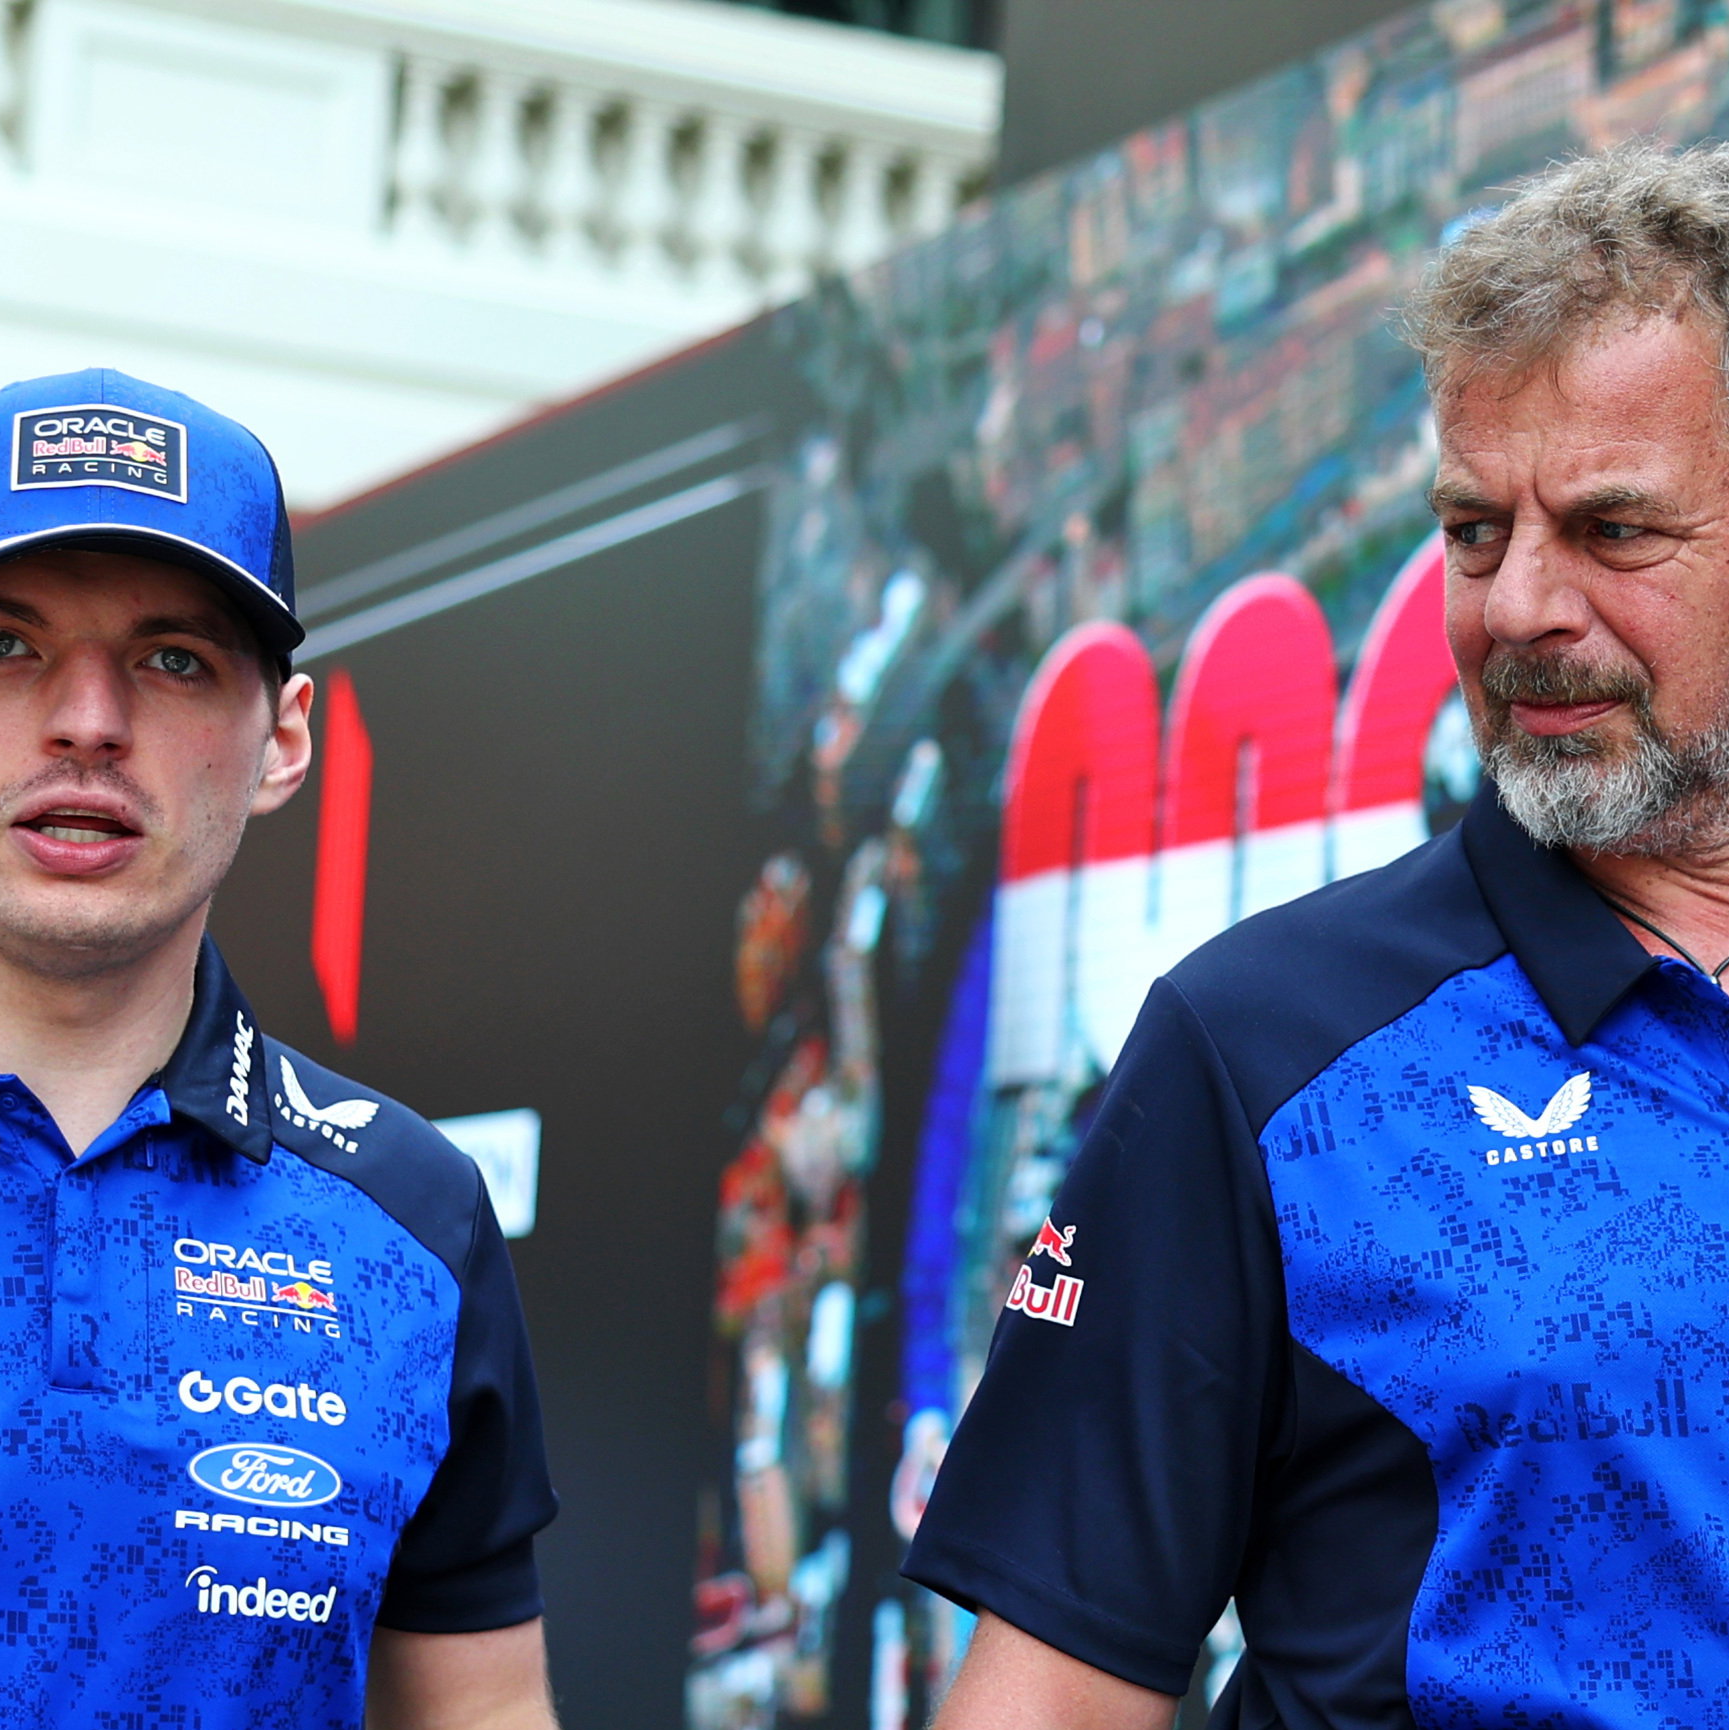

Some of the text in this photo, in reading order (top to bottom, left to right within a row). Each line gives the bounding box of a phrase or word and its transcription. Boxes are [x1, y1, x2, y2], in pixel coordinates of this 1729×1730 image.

[32, 436, 106, 456] Red Bull
[33, 416, 167, 446] ORACLE
[32, 461, 168, 485] RACING
[225, 1009, 254, 1128] DAMAC
[274, 1092, 359, 1155] CASTORE
[1486, 1135, 1599, 1165] CASTORE
[174, 1237, 335, 1285] ORACLE
[174, 1266, 267, 1303] Red Bull
[1005, 1263, 1085, 1327] Bull
[176, 1301, 342, 1339] RACING
[223, 1375, 348, 1426] Gate
[221, 1450, 316, 1499] Ford
[174, 1509, 350, 1547] RACING
[197, 1570, 338, 1623] indeed
